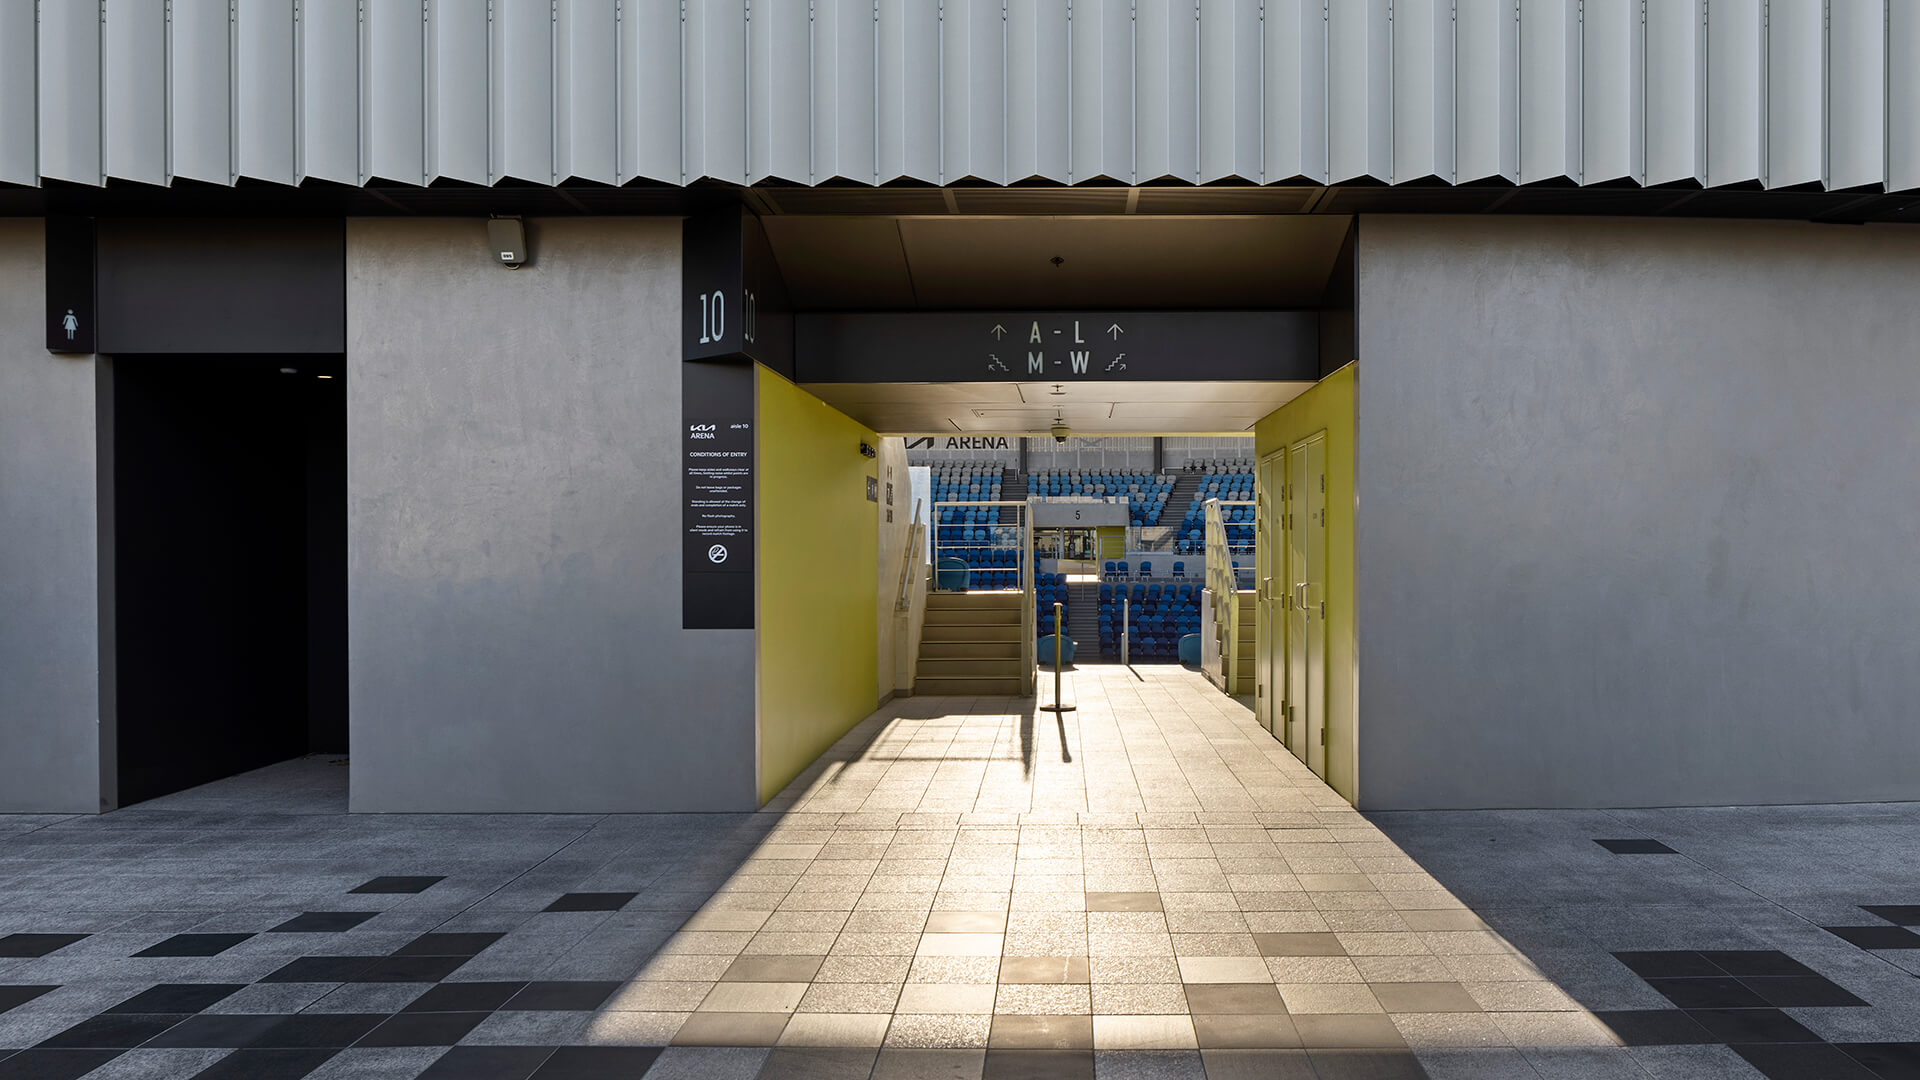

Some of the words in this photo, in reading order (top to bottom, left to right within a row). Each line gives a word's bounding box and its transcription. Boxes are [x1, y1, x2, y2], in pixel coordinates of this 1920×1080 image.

[700, 290, 725, 344] 10
[745, 289, 755, 344] 10
[1029, 321, 1042, 344] A
[1074, 321, 1085, 344] L
[1028, 351, 1044, 374] M
[1069, 351, 1090, 374] W
[946, 437, 1009, 450] ARENA
[1075, 510, 1081, 520] 5
